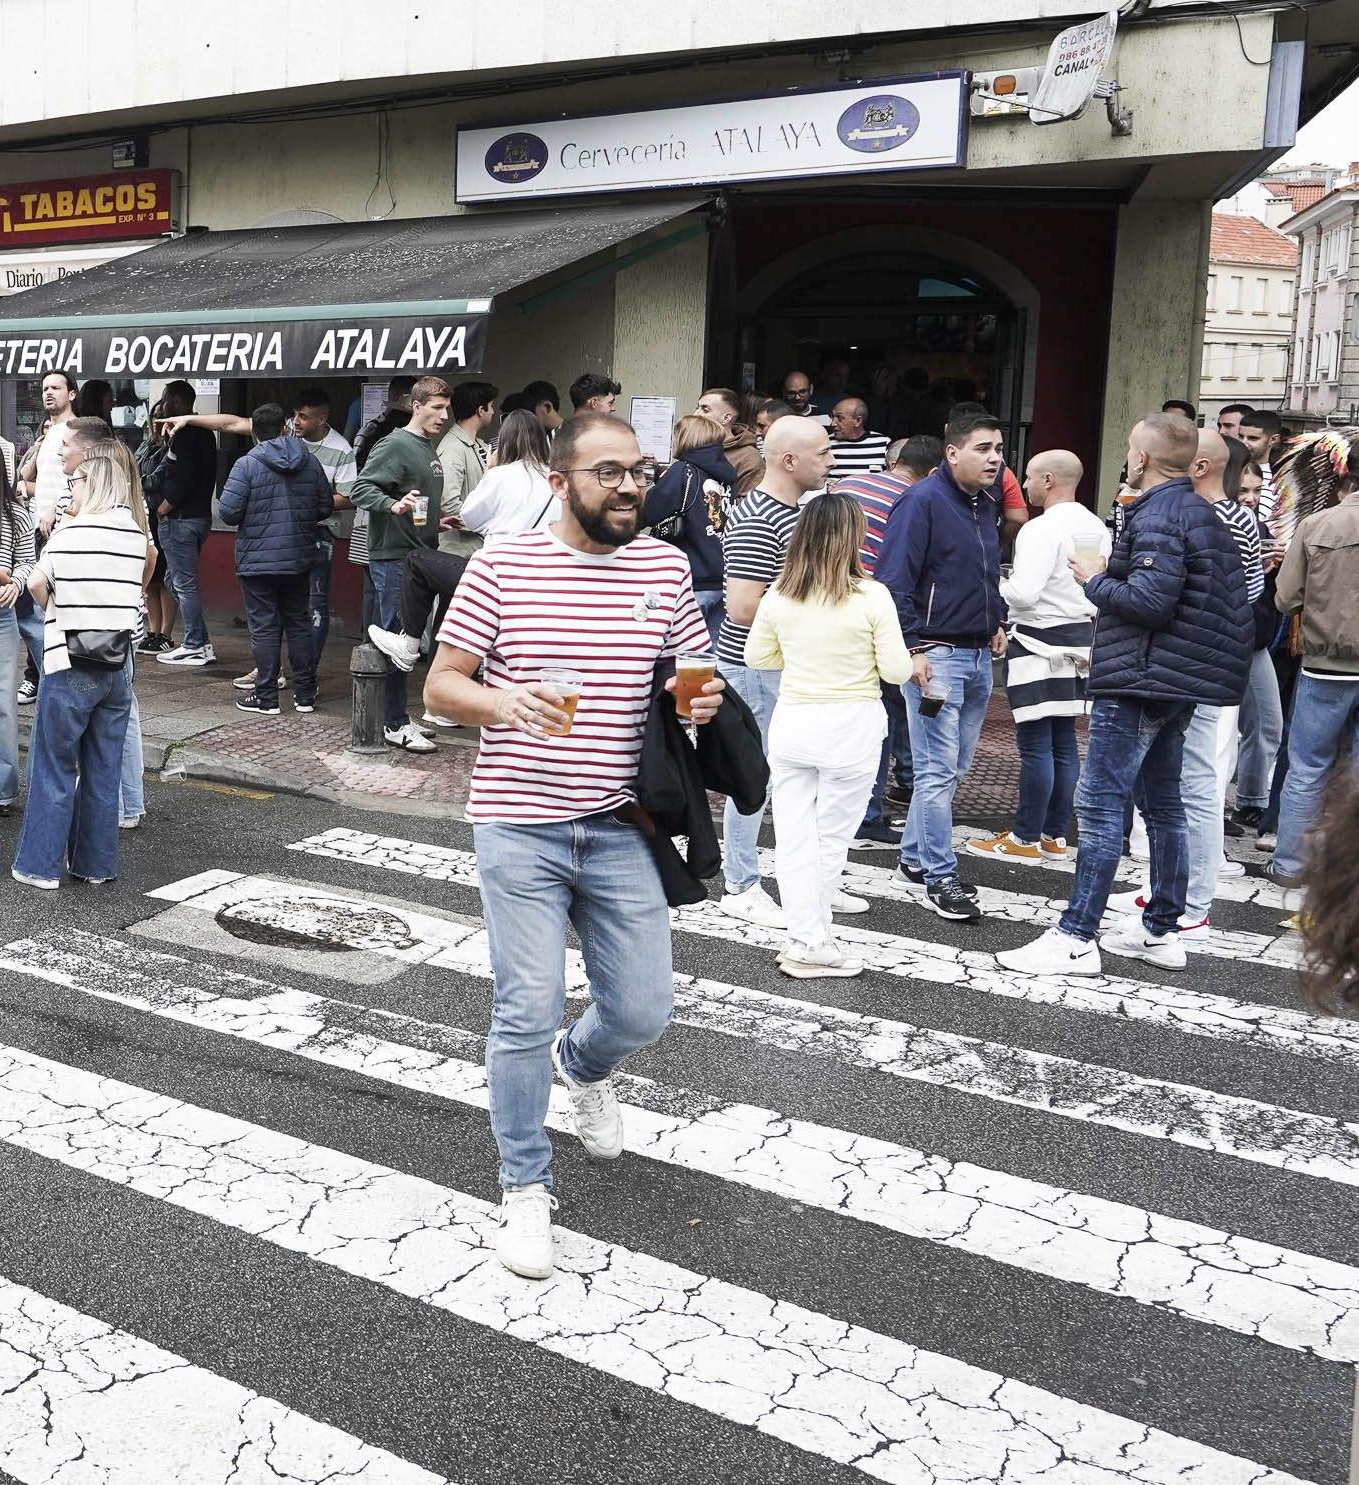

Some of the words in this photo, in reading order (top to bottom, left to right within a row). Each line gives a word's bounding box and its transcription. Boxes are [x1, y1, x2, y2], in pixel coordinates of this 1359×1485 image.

[560, 134, 686, 169] Cervecería
[711, 121, 822, 155] ATALAYA
[20, 182, 157, 221] TABACOS
[118, 214, 135, 223] EXP.
[148, 212, 154, 221] 3
[5, 267, 43, 288] Diario
[104, 331, 284, 374] BOCATERIA
[310, 326, 468, 370] ATALAYA
